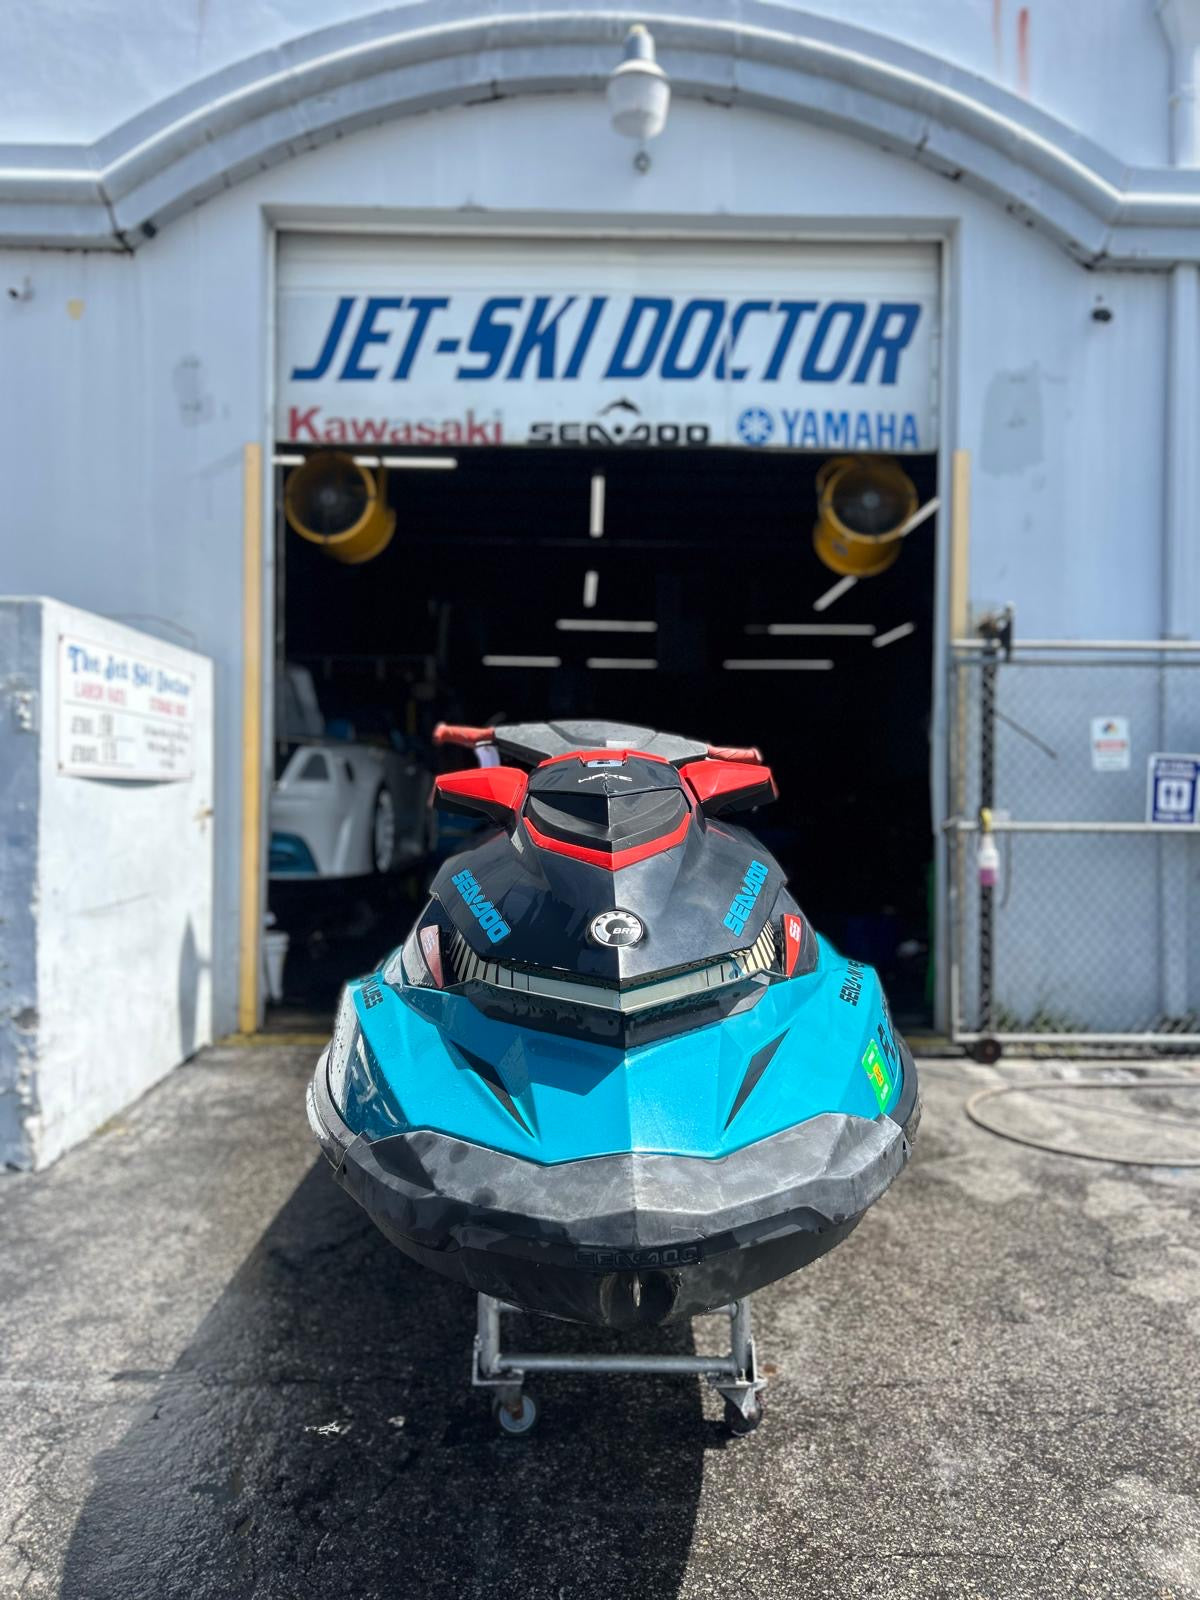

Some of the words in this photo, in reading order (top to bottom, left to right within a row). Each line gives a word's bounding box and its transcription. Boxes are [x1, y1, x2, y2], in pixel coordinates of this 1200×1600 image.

[290, 296, 607, 382] JET-SKI
[603, 296, 921, 386] DOCTOR
[288, 406, 504, 445] Kawasaki
[781, 408, 920, 449] YAMAHA
